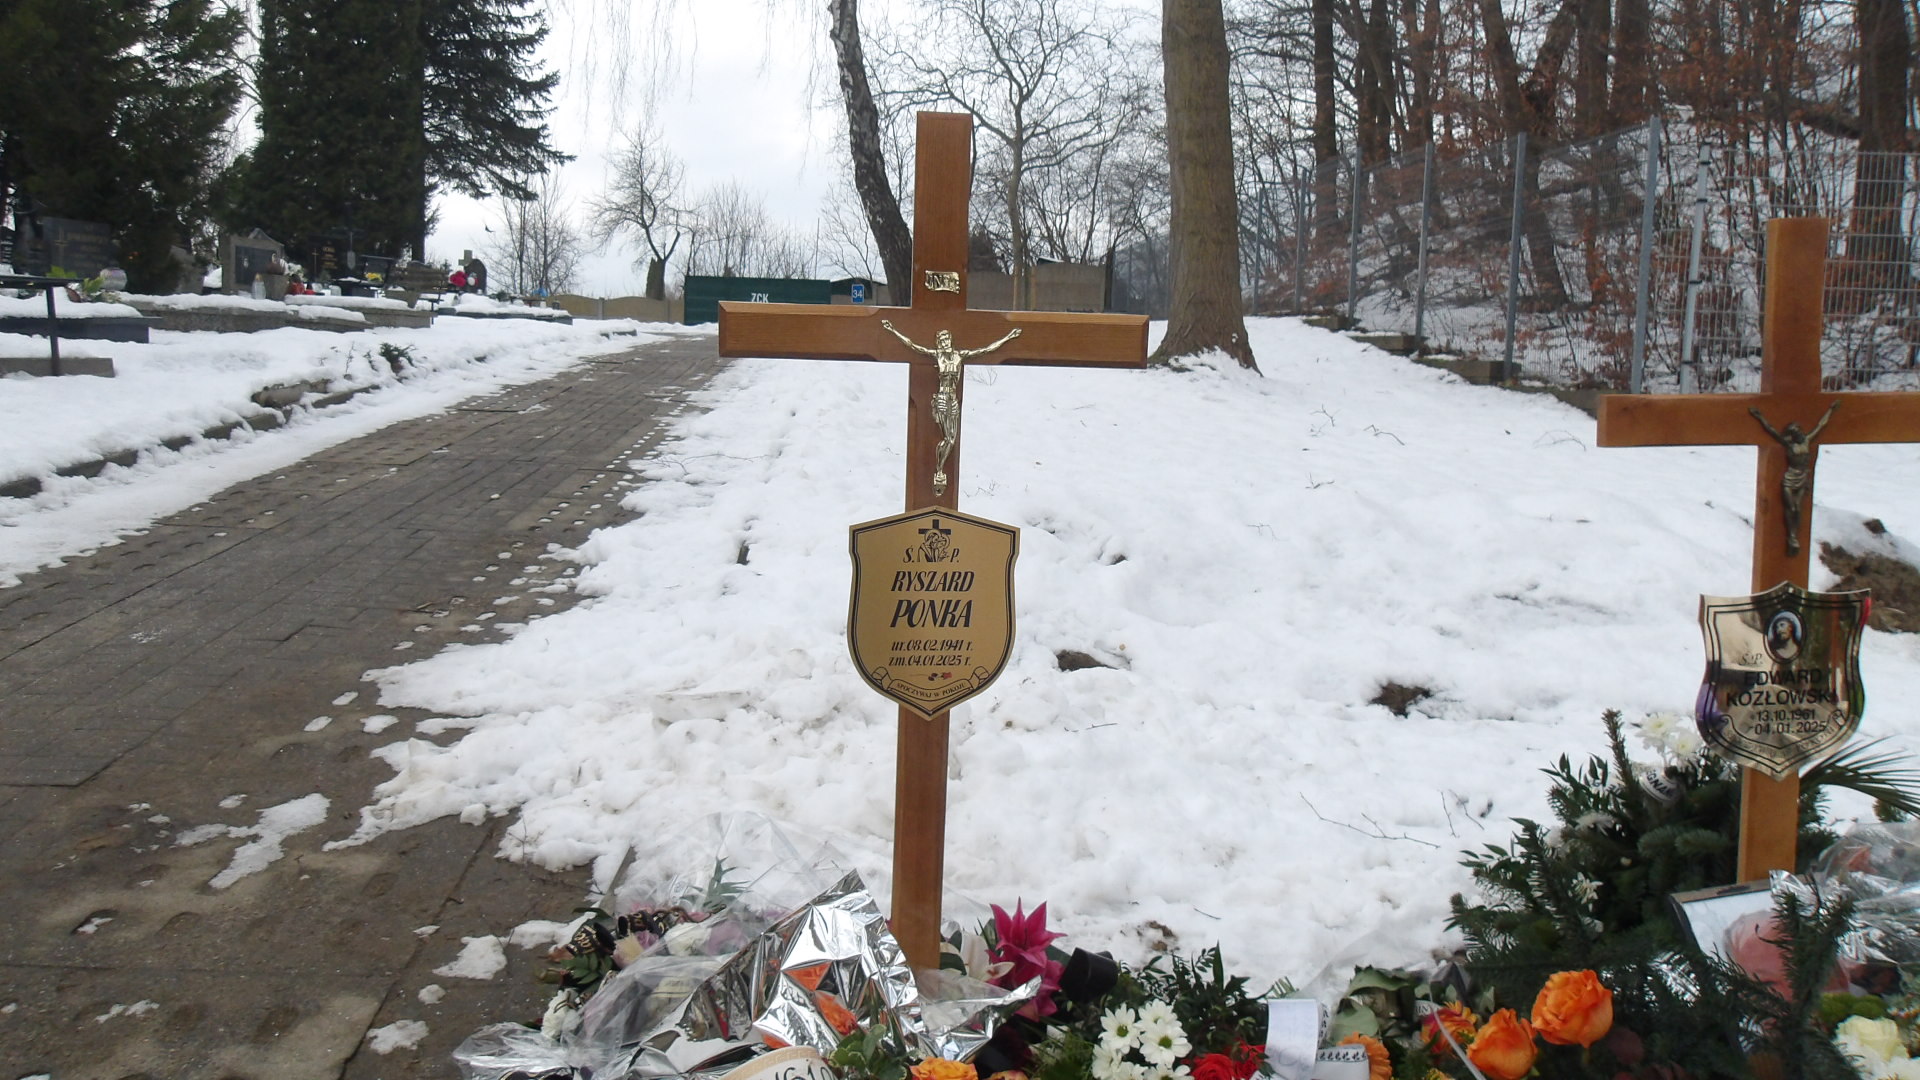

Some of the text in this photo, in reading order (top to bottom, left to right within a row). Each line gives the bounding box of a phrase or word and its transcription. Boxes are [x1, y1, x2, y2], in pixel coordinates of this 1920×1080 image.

[751, 292, 769, 303] ZCK
[852, 288, 863, 299] 34
[891, 571, 975, 592] RYSZARD
[890, 599, 972, 628] PONKA
[1745, 668, 1822, 686] EDWARD
